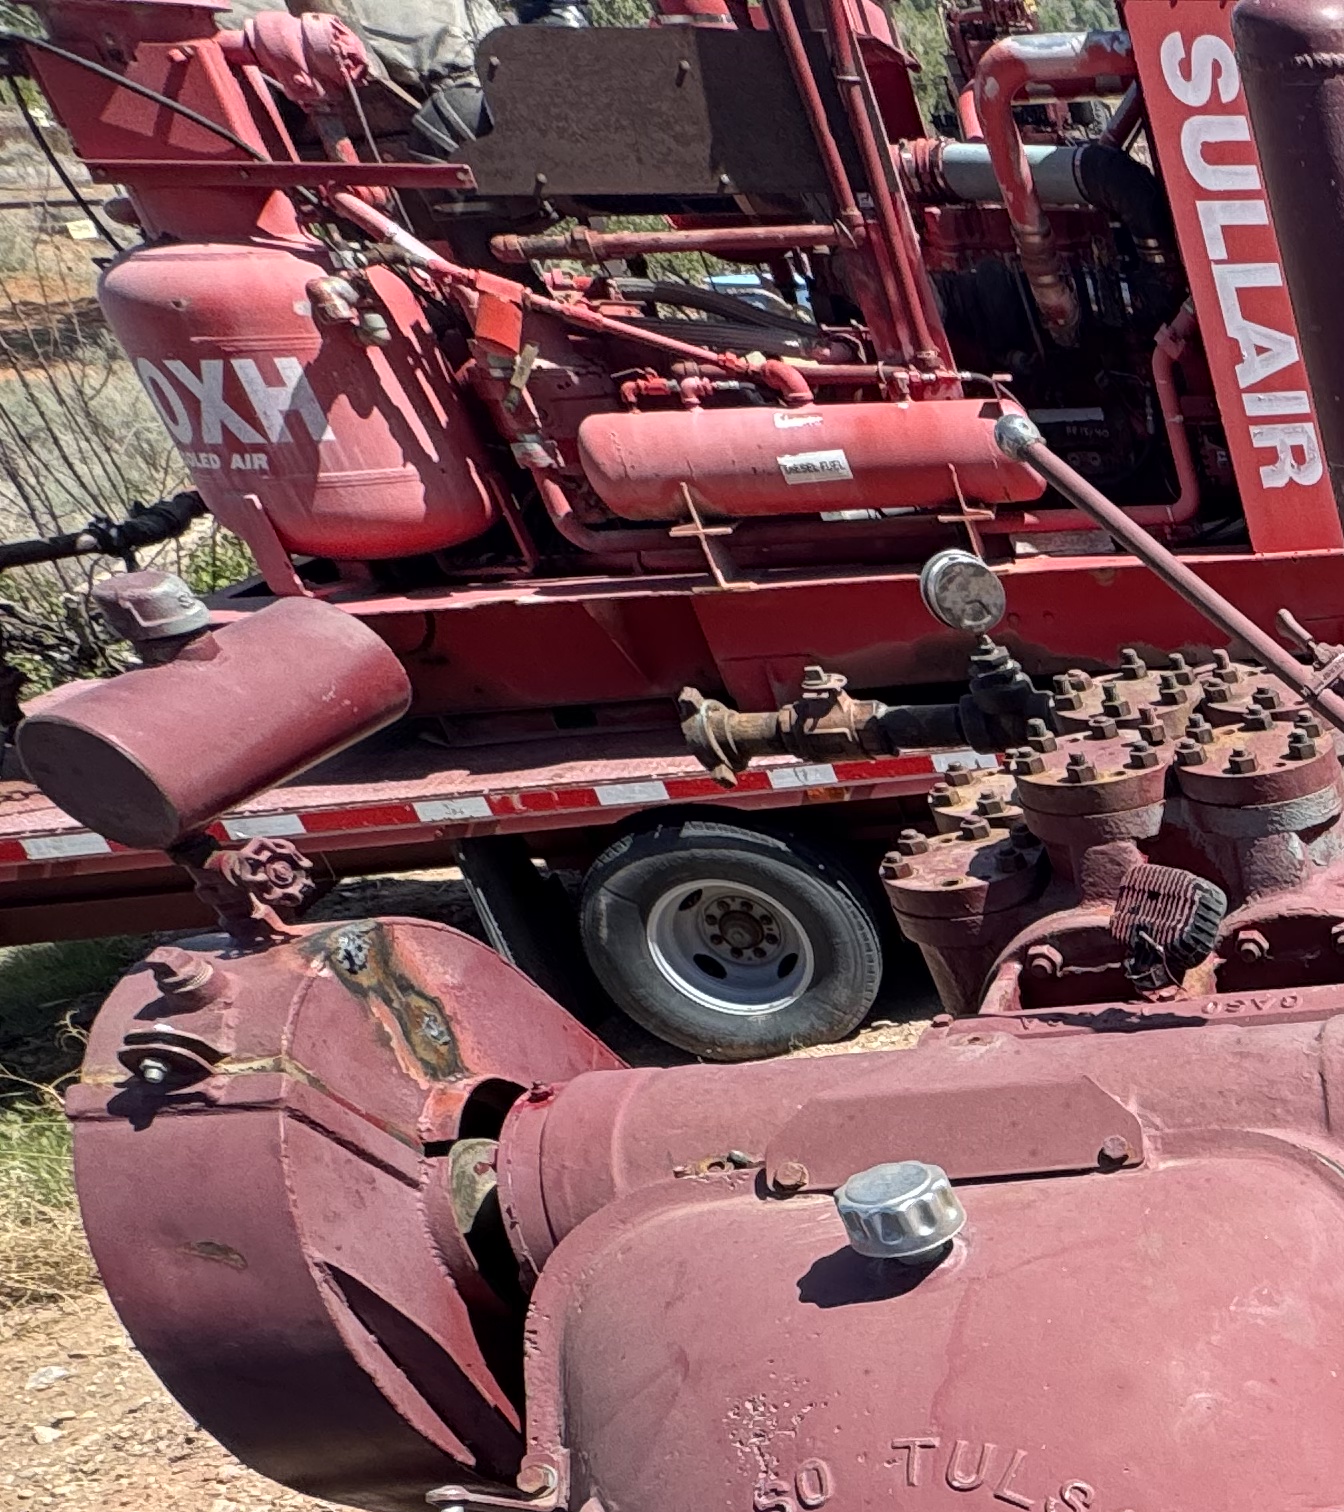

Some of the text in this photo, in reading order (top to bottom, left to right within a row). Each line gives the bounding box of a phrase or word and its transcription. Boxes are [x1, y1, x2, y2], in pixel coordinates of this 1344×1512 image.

[1160, 31, 1323, 489] SULLAIR
[230, 453, 270, 470] AIR
[819, 460, 846, 472] FUEL
